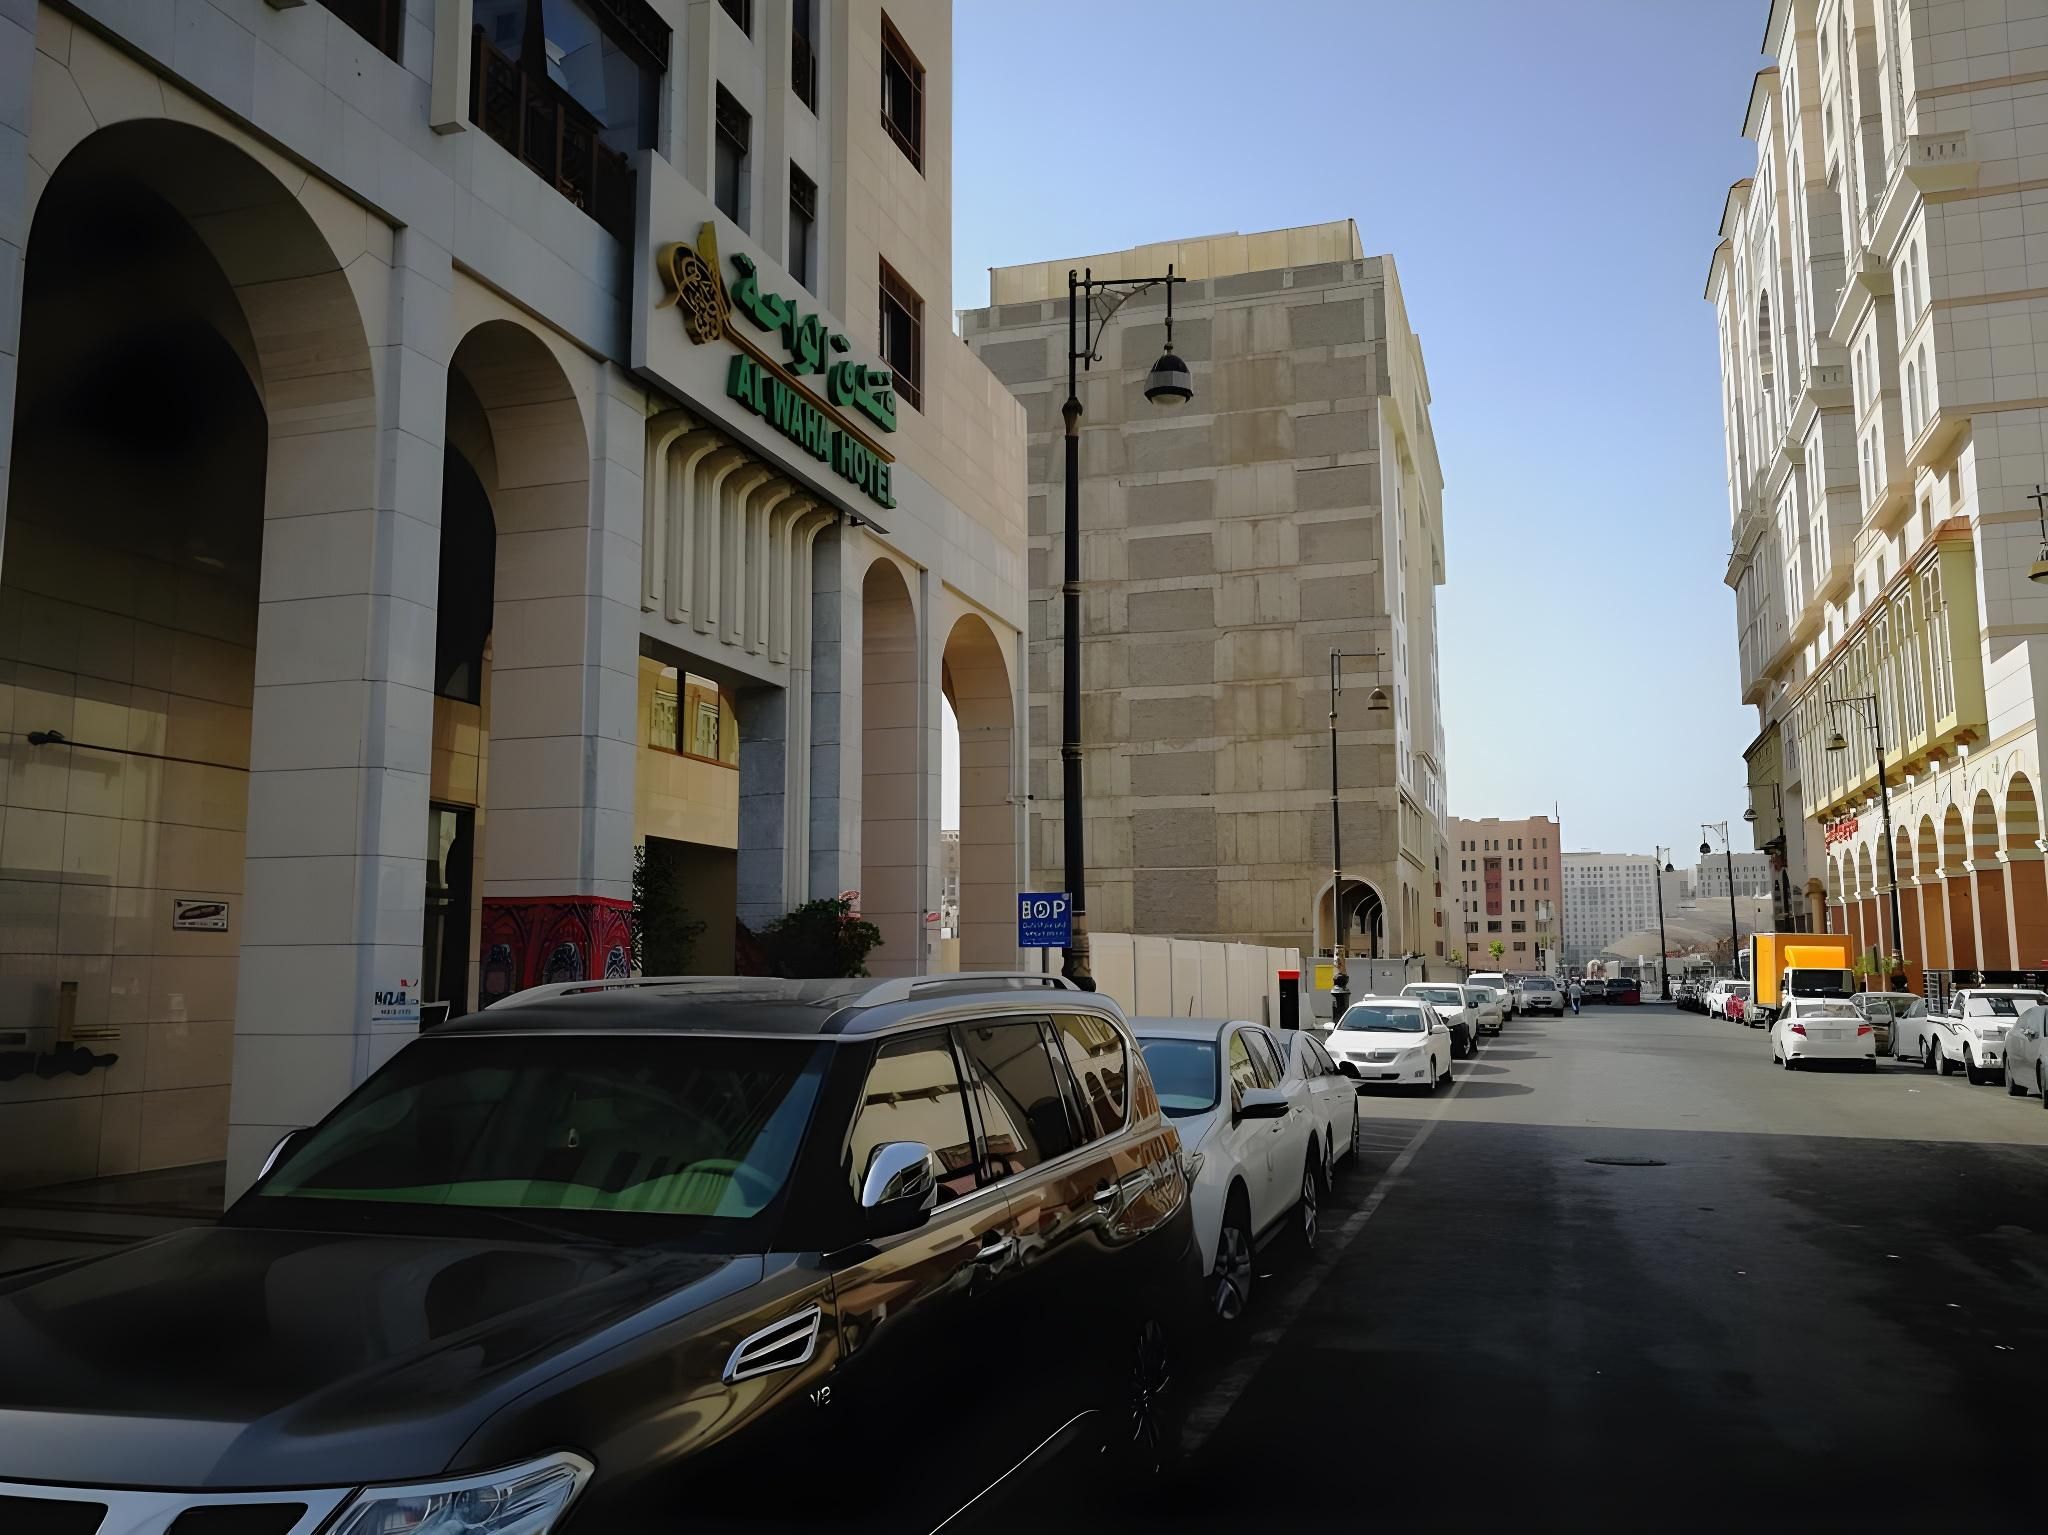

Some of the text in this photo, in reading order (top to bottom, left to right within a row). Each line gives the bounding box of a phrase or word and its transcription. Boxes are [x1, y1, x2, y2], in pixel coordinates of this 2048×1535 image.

[731, 252, 897, 433] فندق الواحة
[728, 353, 897, 509] AL WAHA HOTEL
